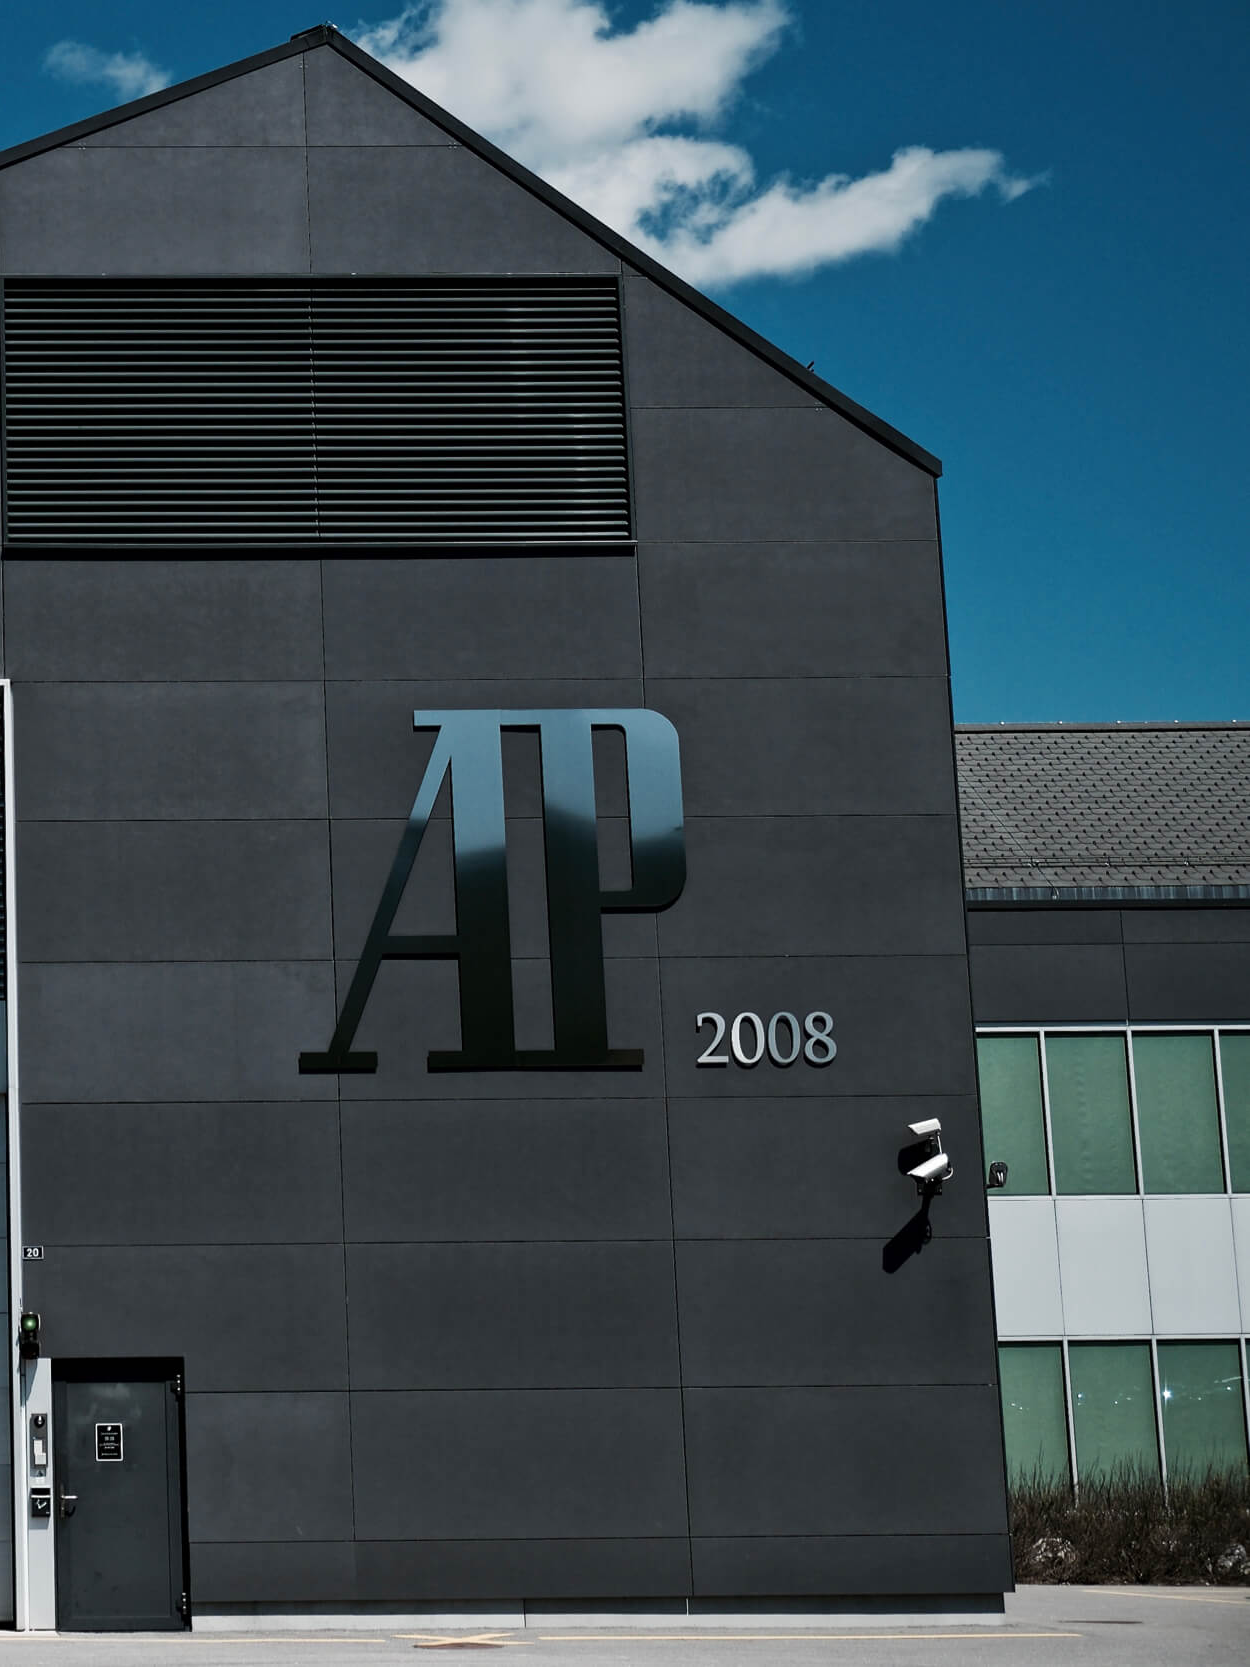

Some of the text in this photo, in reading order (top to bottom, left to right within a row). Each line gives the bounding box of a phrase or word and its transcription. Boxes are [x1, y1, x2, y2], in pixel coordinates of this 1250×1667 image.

[299, 708, 687, 1072] AP
[696, 1011, 837, 1065] 2008
[26, 1247, 39, 1258] 20
